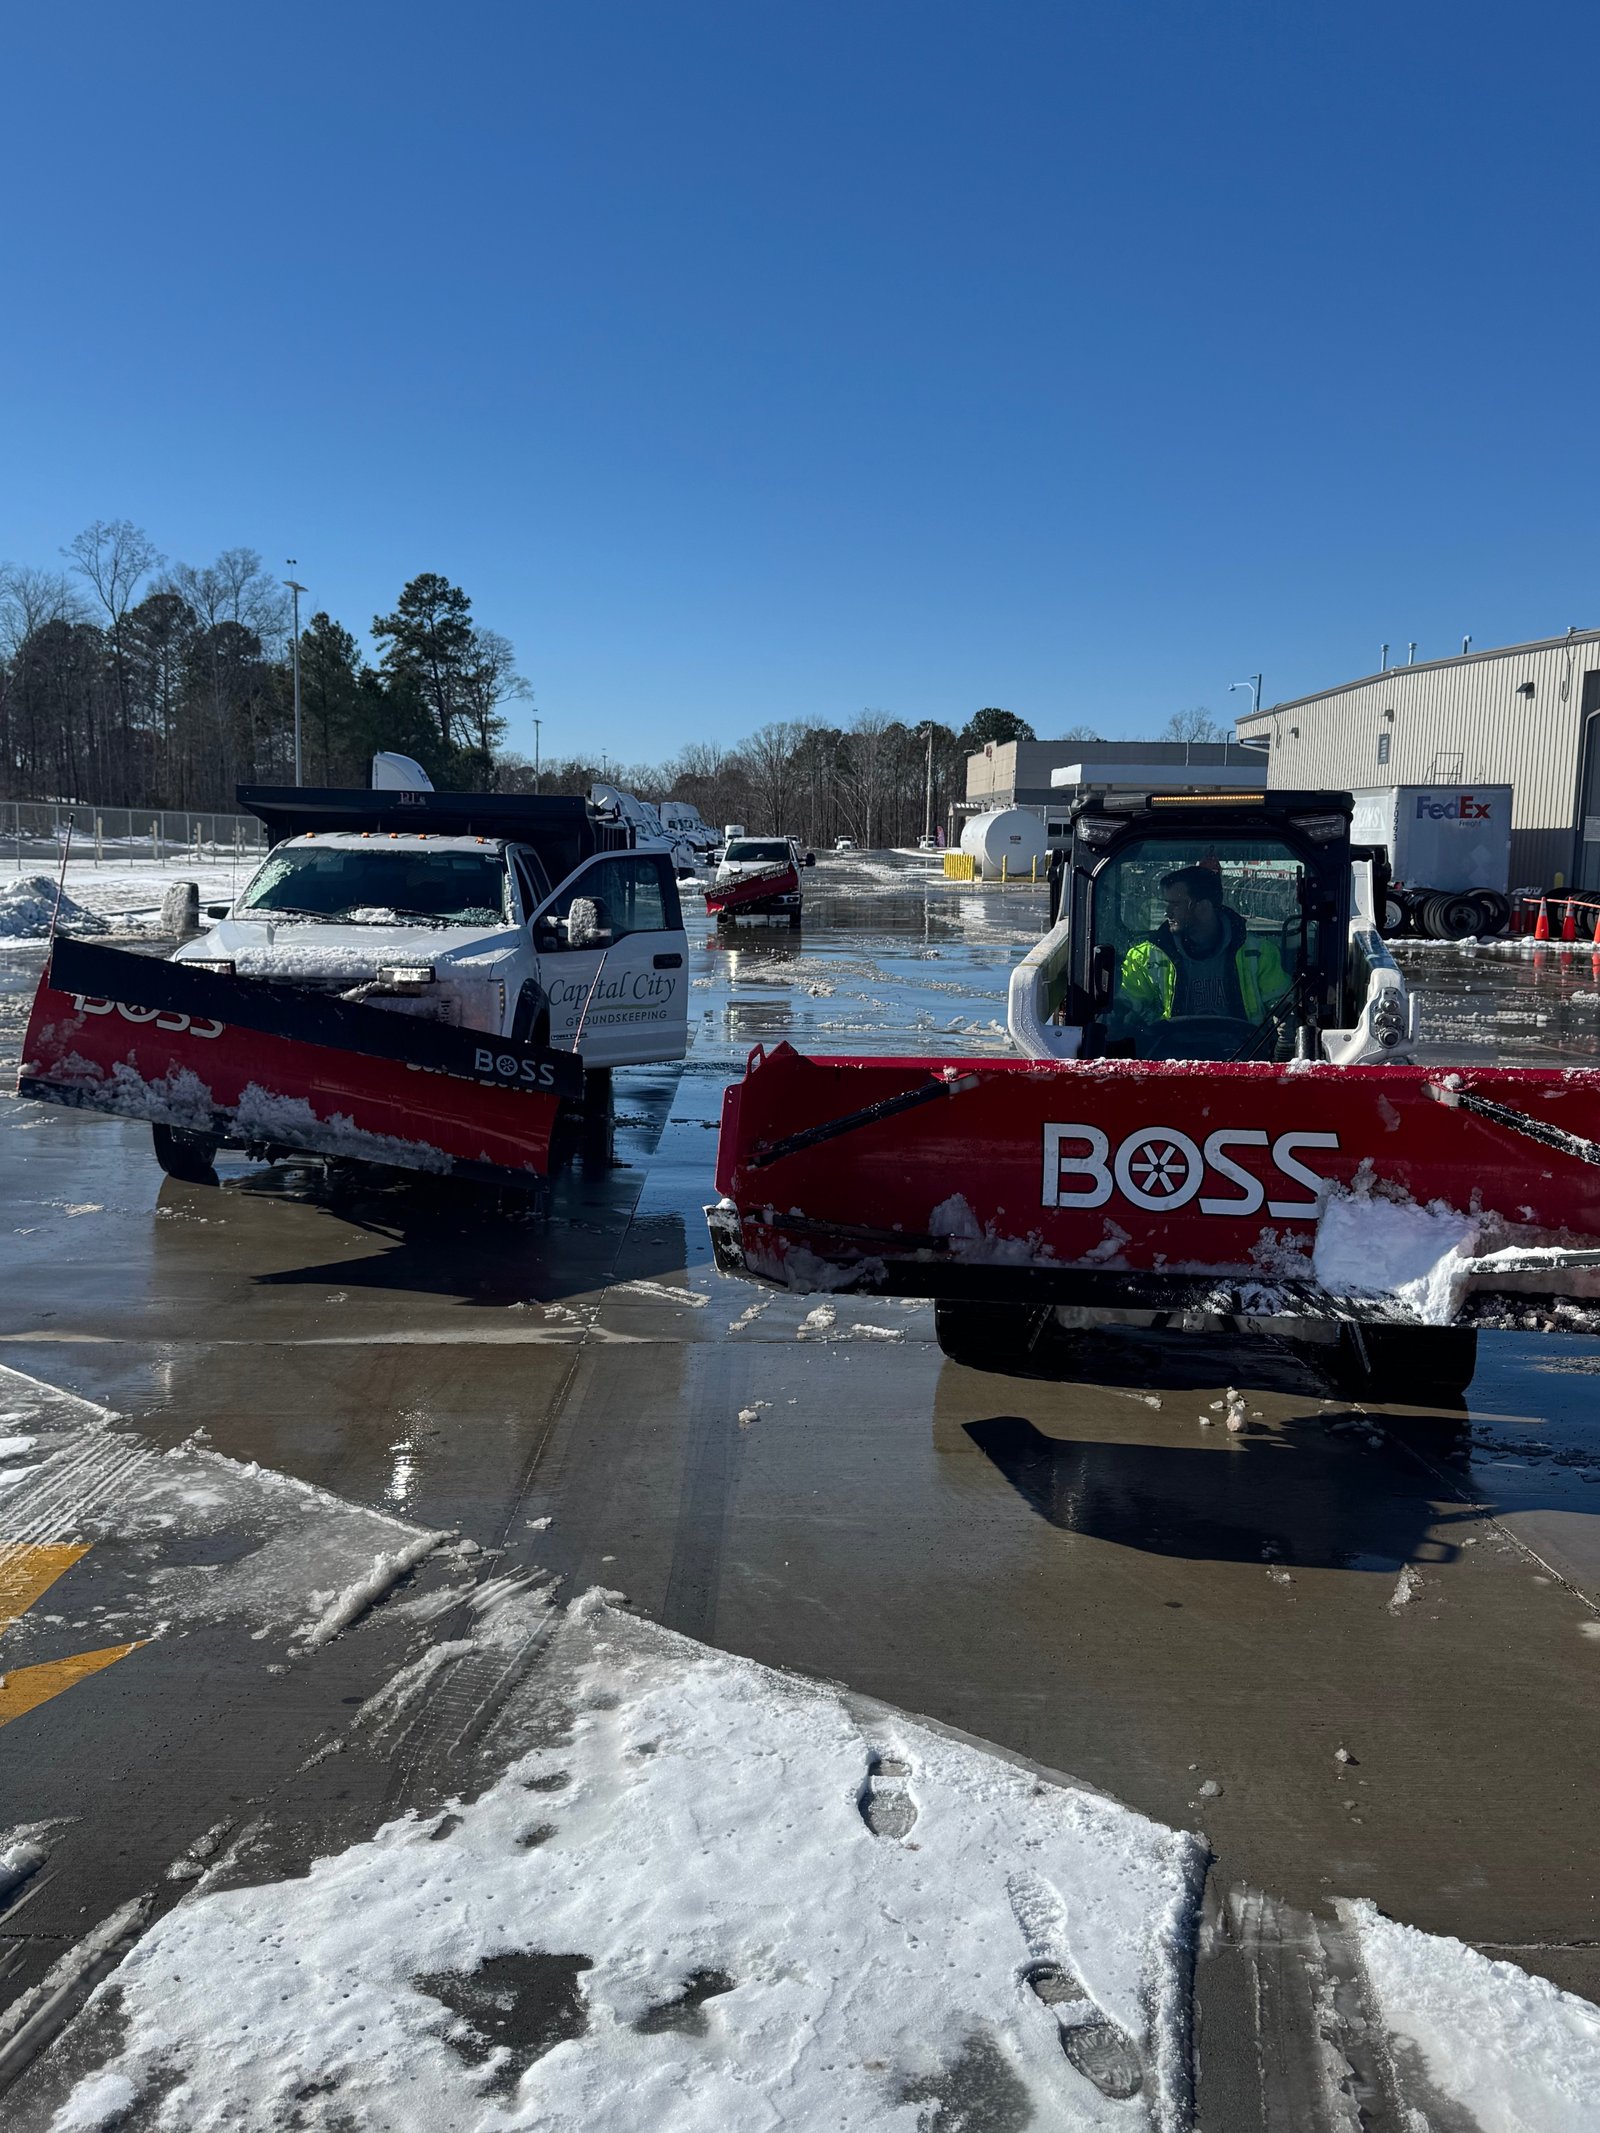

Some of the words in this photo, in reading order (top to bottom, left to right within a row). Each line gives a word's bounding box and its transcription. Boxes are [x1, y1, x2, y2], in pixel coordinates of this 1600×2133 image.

[1416, 796, 1491, 819] FedEx
[633, 972, 676, 1003] City
[565, 1010, 667, 1027] GROUNDSKEEPING
[475, 1048, 555, 1086] BOSS
[1041, 1122, 1340, 1219] BOSS
